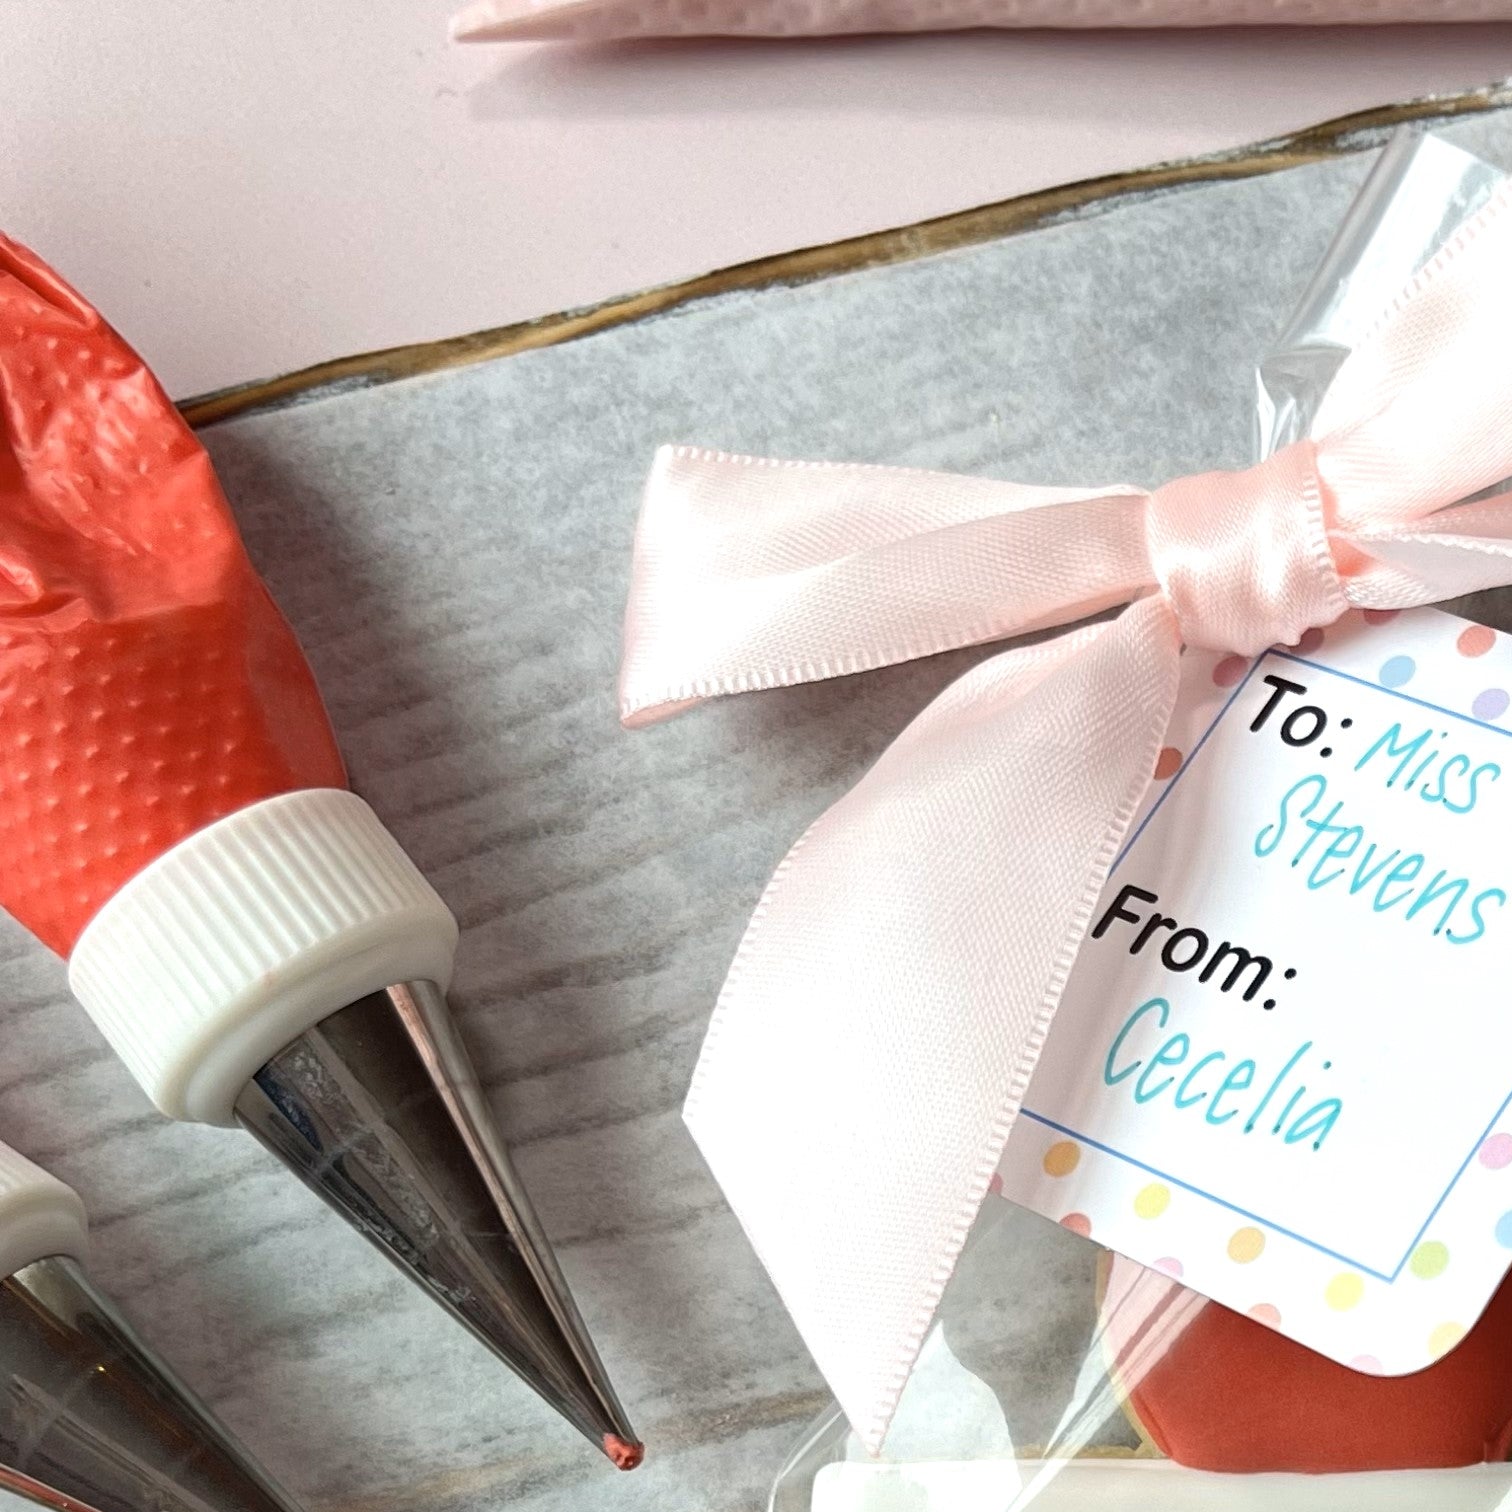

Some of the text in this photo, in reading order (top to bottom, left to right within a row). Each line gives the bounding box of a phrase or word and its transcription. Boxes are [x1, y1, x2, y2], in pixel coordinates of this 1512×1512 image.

[1249, 675, 1502, 814] To: Miss
[1255, 775, 1507, 945] Stevens
[1091, 885, 1297, 1010] From:
[1104, 999, 1342, 1151] Cecelia
